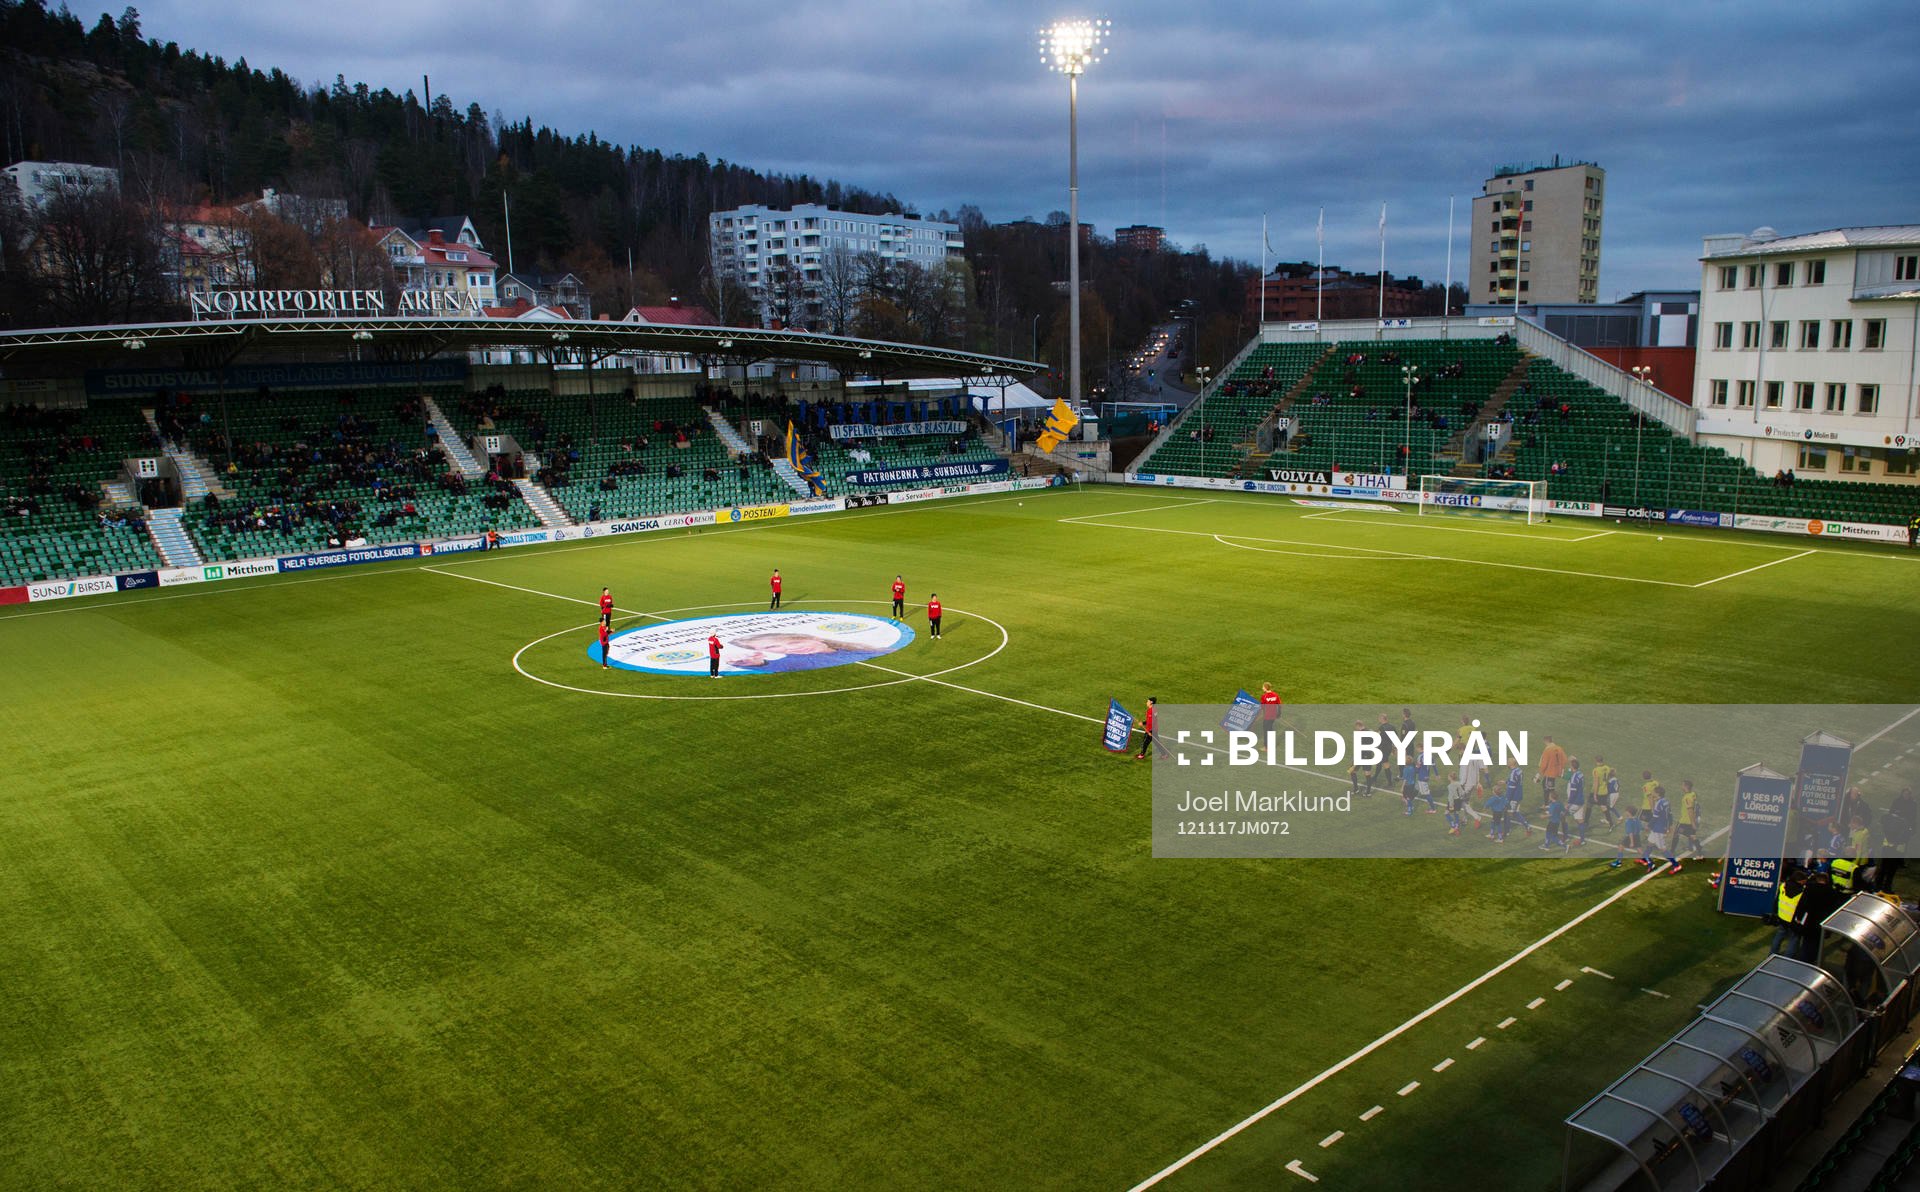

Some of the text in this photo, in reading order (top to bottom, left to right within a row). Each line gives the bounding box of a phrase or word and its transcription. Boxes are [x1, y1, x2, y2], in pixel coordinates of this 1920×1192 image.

[190, 289, 479, 313] NORRPORTEN ARENA
[1814, 431, 1829, 439] Molin
[863, 464, 978, 483] PATRONERNA SUNDSVALL
[1270, 469, 1327, 484] VOLVIA
[1356, 474, 1392, 488] THAI
[905, 491, 934, 501] ServaNet
[789, 502, 836, 513] Handelsbanken
[1555, 501, 1591, 511] PEAB
[1627, 508, 1665, 520] adidas
[611, 519, 659, 534] SKANSKA
[1842, 525, 1880, 536] Mitthem
[284, 547, 414, 569] HELA SVERIGES FOTBOLLSKLUBB
[227, 564, 275, 576] Mitthem
[33, 580, 113, 598] SUND BIRSTA
[1742, 792, 1784, 804] VI SES PÅ
[1744, 800, 1779, 813] LÖRDAG
[1733, 858, 1775, 870] VI SES PÅ
[1736, 867, 1770, 879] LÖRDAG
